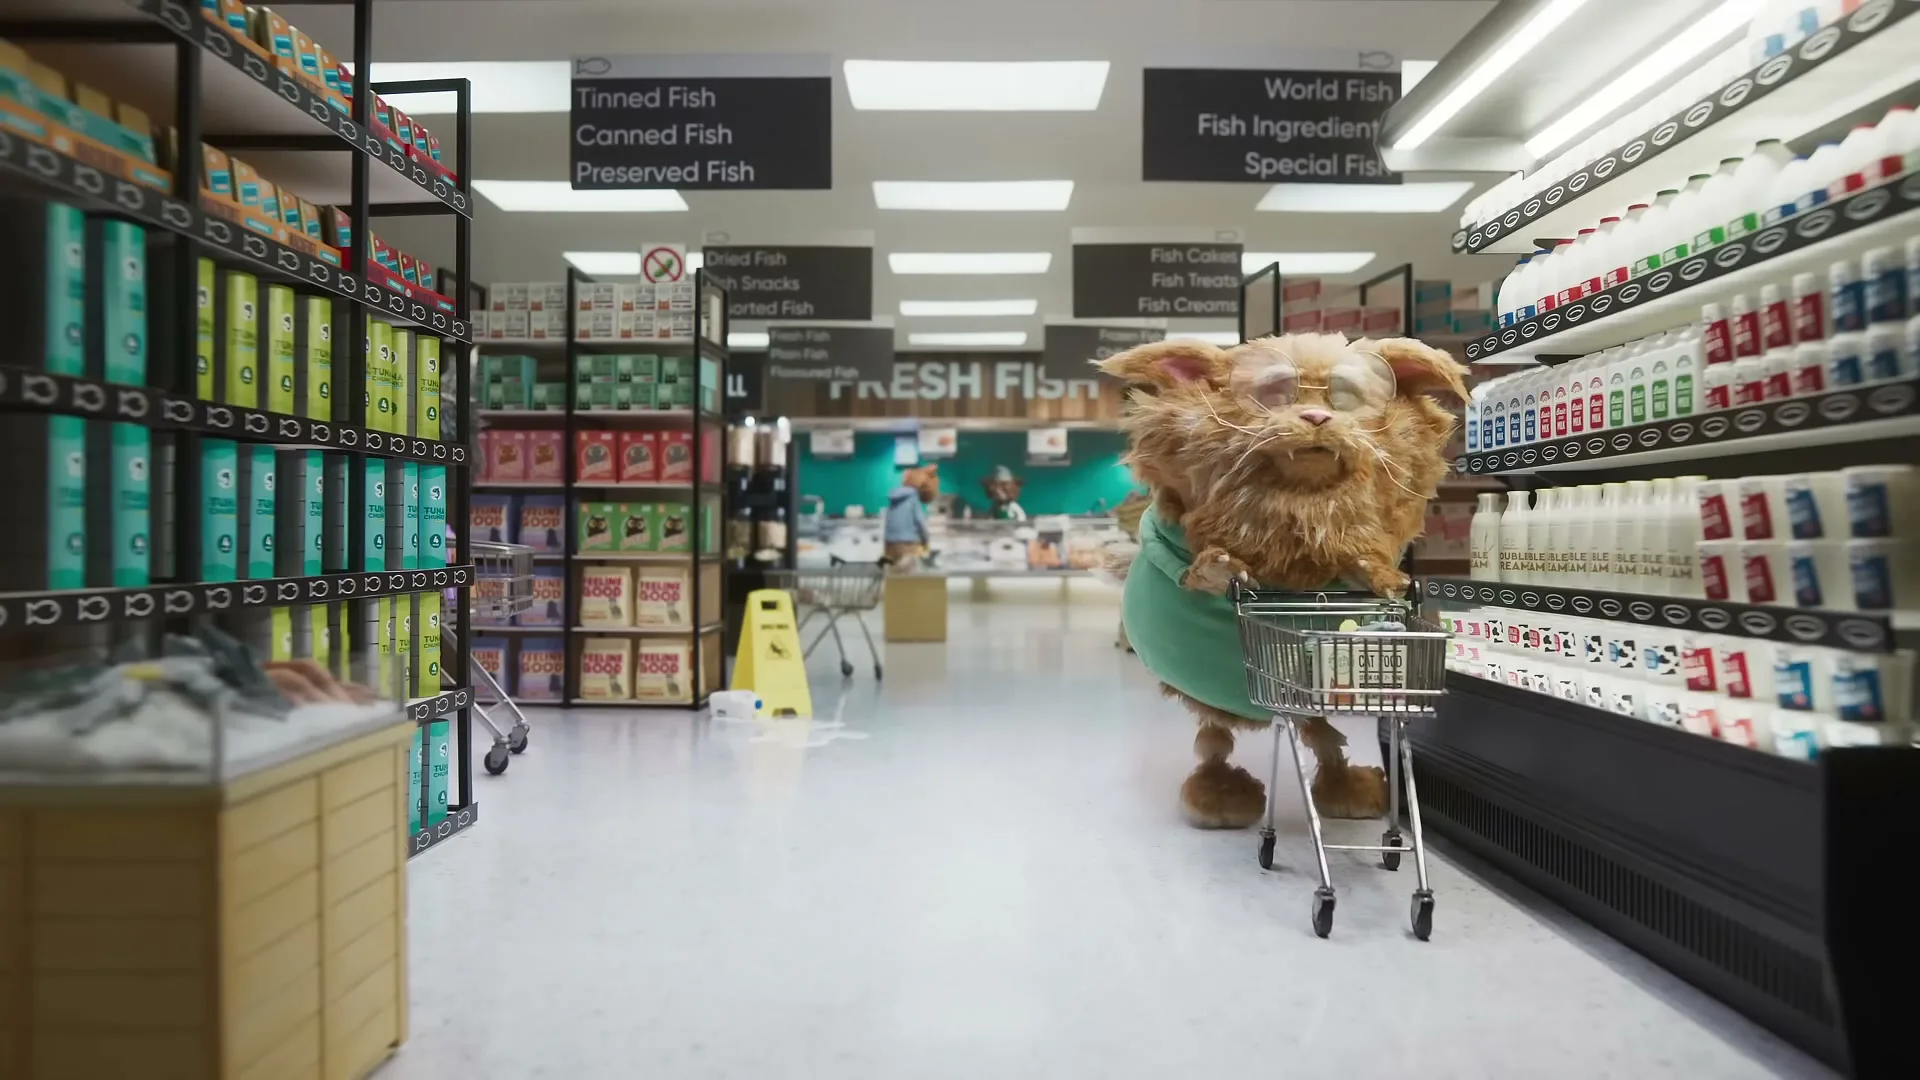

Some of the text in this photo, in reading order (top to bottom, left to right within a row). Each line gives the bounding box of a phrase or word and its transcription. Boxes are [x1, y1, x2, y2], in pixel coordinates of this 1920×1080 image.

[576, 86, 716, 109] Tinned Fish
[1264, 77, 1393, 102] World Fish
[576, 123, 733, 146] Canned Fish
[1198, 113, 1378, 143] Fish Ingredient
[577, 160, 754, 183] Preserved Fish
[1245, 152, 1338, 179] Special
[706, 251, 787, 267] Dried Fish
[1151, 247, 1238, 263] Fish Cakes
[742, 275, 800, 291] Snacks
[1152, 272, 1238, 288] Fish Treats
[782, 300, 814, 316] Fish
[1138, 297, 1238, 313] Fish Creams
[1500, 562, 1528, 571] REAM
